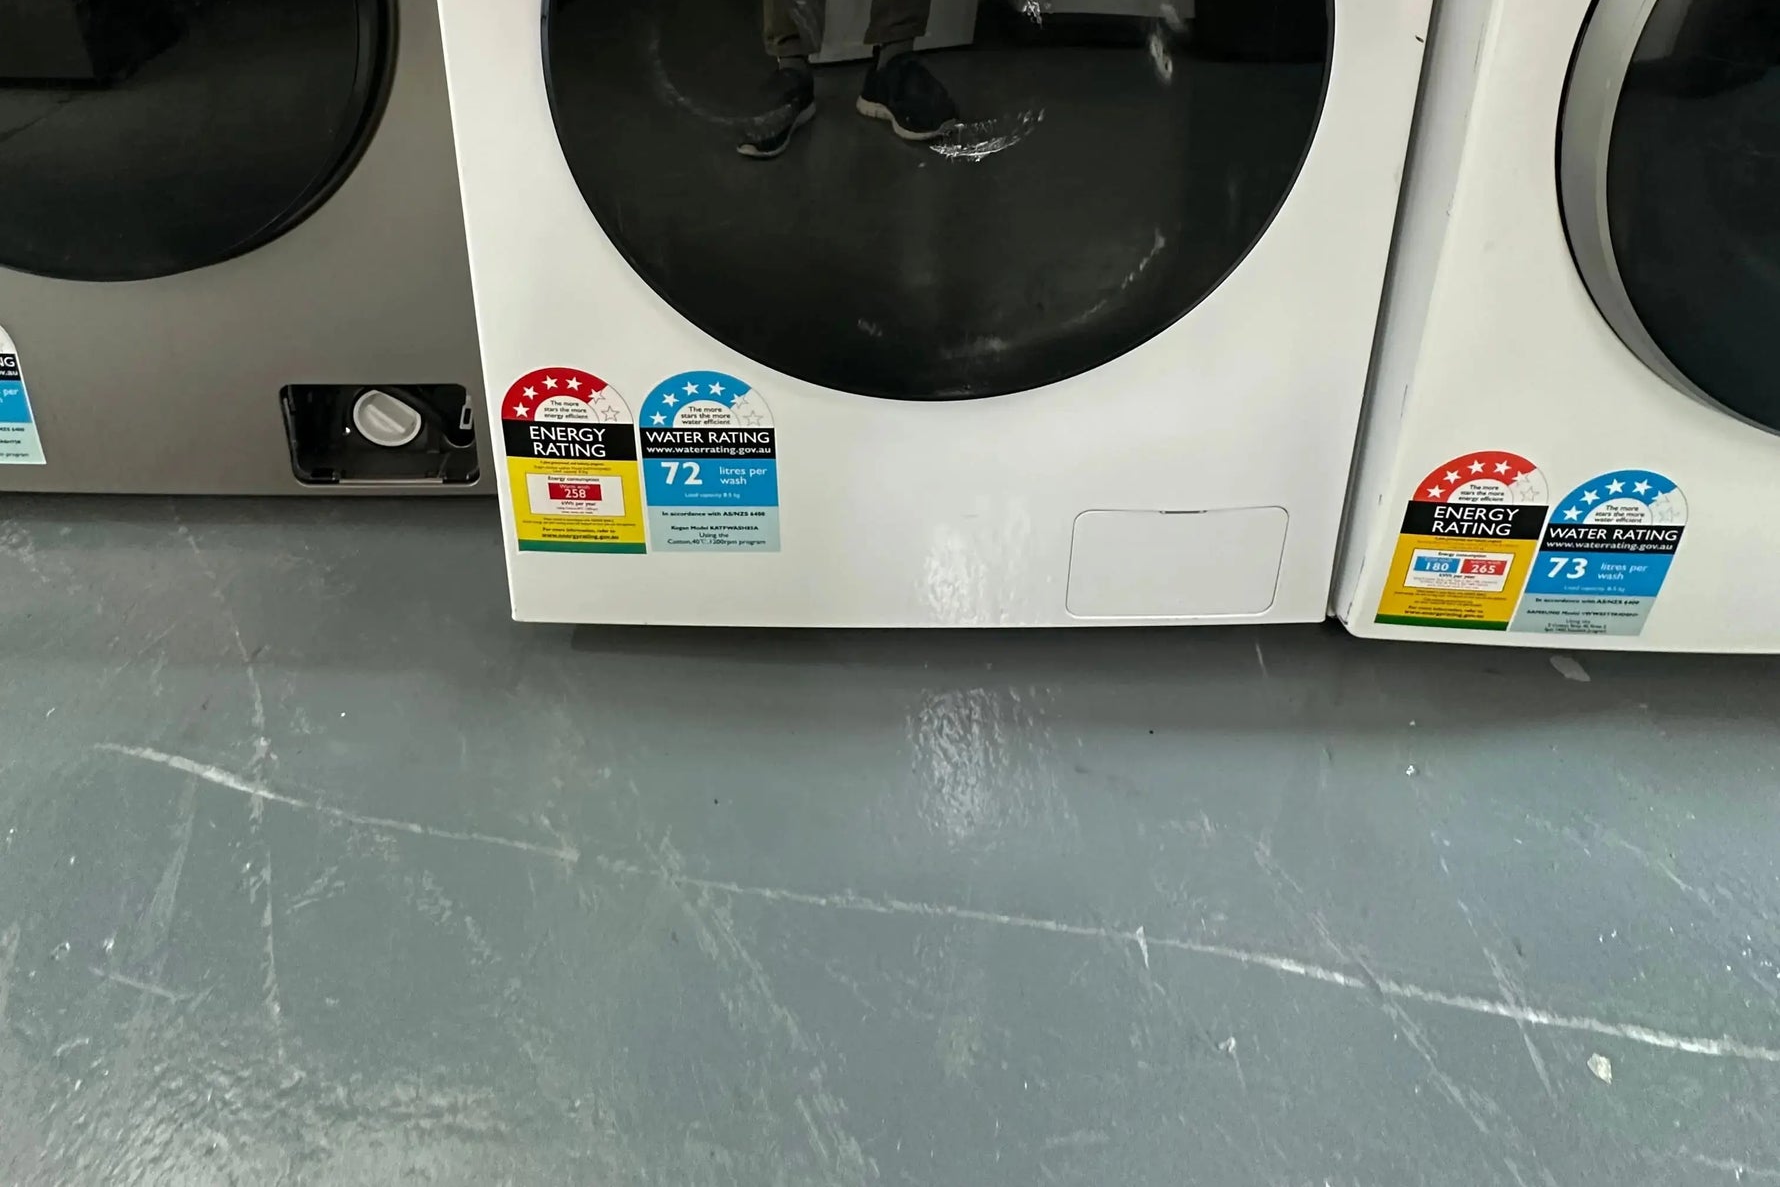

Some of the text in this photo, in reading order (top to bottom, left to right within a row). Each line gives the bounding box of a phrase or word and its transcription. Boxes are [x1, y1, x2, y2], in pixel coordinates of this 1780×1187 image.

[529, 425, 606, 442] ENERGY
[646, 431, 770, 444] WATER RATING
[533, 441, 606, 457] RATING
[646, 446, 771, 455] www.waterrating.gov.au
[661, 461, 703, 485] 72
[719, 466, 767, 477] litres per
[720, 476, 747, 485] wash
[564, 488, 586, 498] 258
[1434, 505, 1519, 521] ENERGY
[1432, 520, 1512, 535] RATING
[1549, 527, 1679, 541] WATER RATING
[1546, 541, 1673, 551] www.waterrating.gov.au
[1425, 562, 1496, 574] 180 265
[1548, 557, 1588, 579] 73
[1601, 562, 1648, 573] litres per
[1597, 572, 1625, 580] wash
